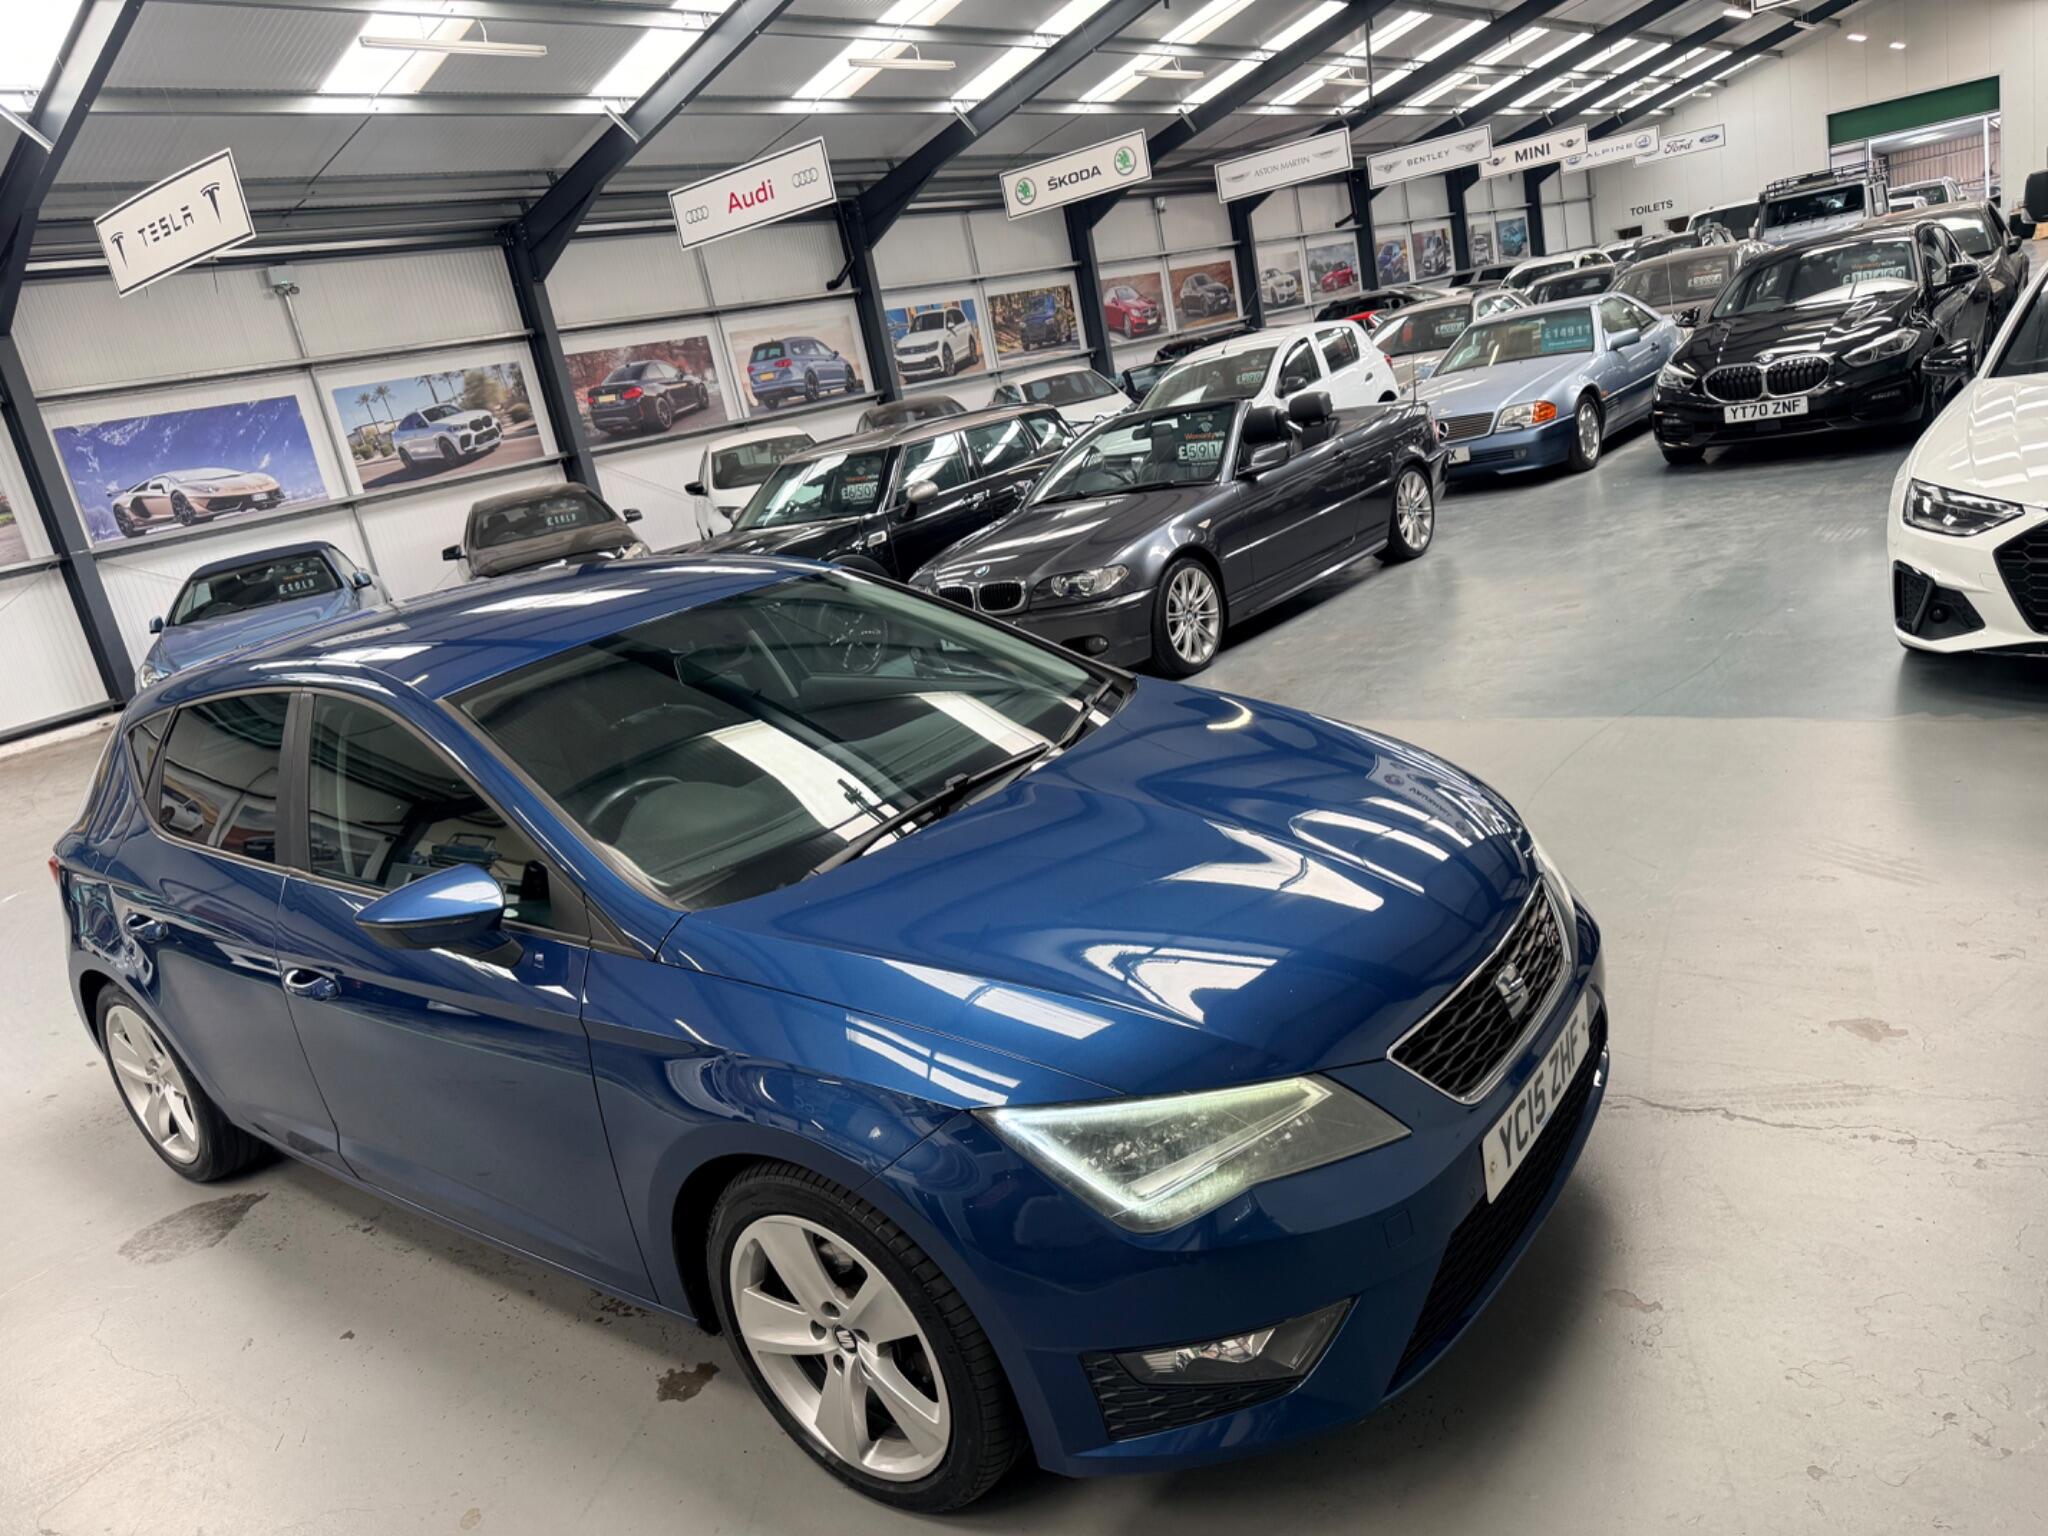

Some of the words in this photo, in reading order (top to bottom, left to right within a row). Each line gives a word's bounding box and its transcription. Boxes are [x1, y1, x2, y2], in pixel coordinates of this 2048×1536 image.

[1406, 148, 1451, 167] BENTLEY
[1515, 142, 1551, 163] MINI
[1585, 143, 1633, 158] ALPINE
[1254, 165, 1280, 177] ASTON
[1280, 156, 1310, 170] MARTIN
[1048, 165, 1102, 191] ŠKODA
[728, 179, 775, 215] Audi
[1630, 200, 1674, 217] TOILETS
[137, 205, 195, 248] TESLA
[1730, 404, 1768, 419] YT70
[1772, 400, 1801, 415] ZNF
[1178, 440, 1223, 460] £591
[1498, 1070, 1547, 1168] YC15
[1548, 1014, 1579, 1102] ZHF
